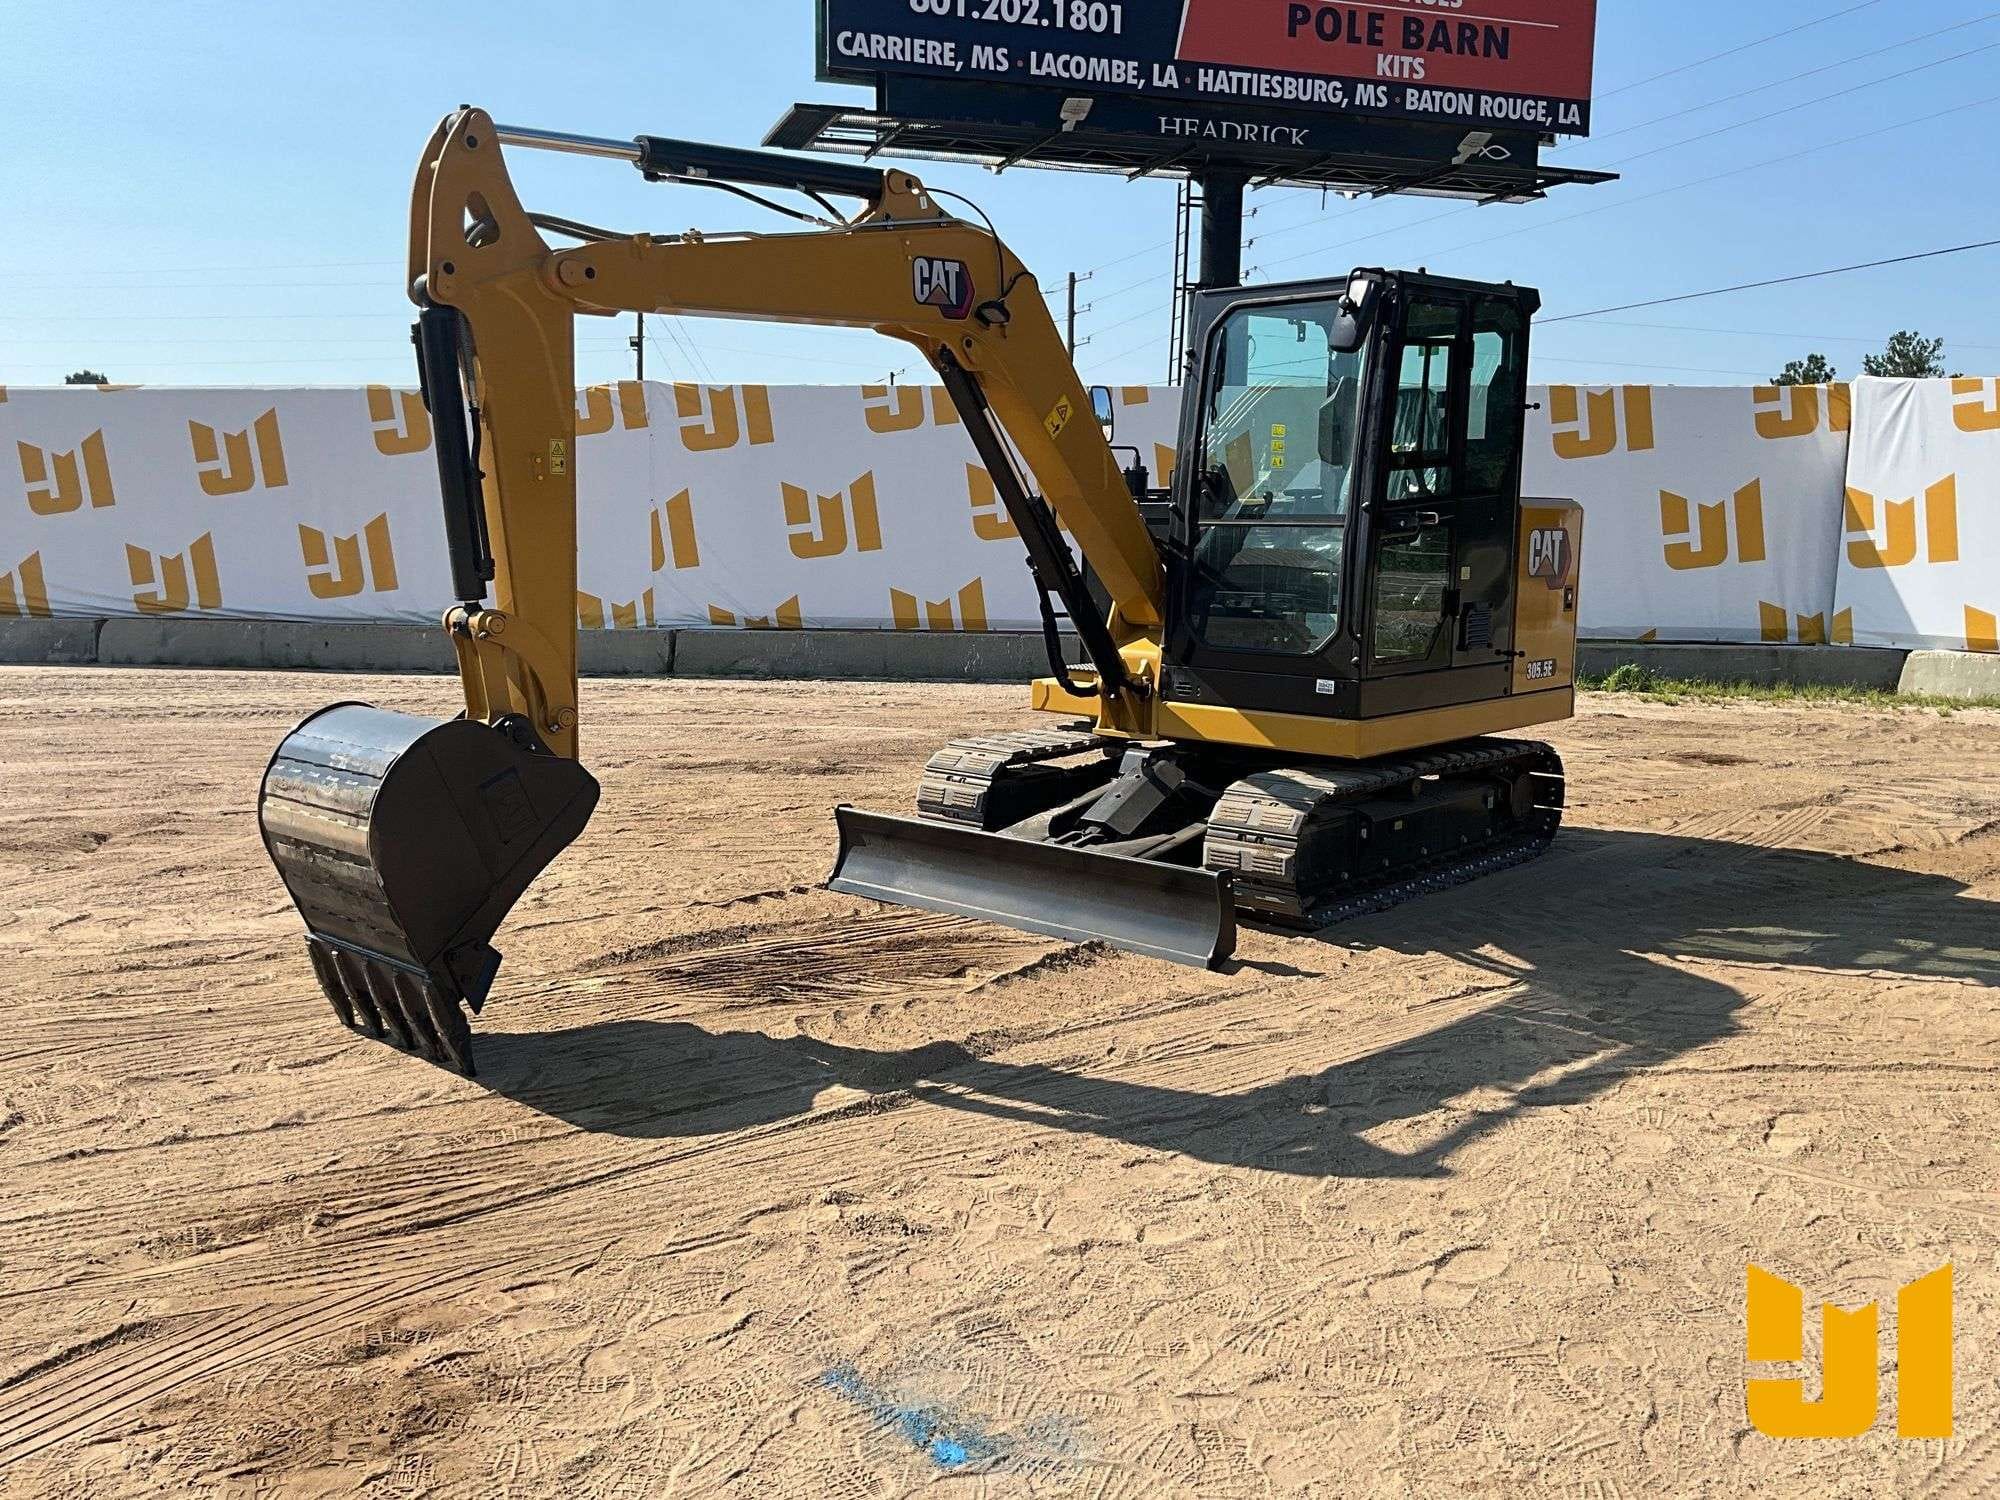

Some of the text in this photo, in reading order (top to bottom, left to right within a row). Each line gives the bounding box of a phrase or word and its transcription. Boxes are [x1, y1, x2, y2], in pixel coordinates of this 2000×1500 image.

[1287, 4, 1510, 60] POLE BARN
[836, 30, 1581, 127] CARRIERE, MS LACOMBE, LA HATTIESBURG, MS BATON ROUGE, LA
[1375, 53, 1426, 80] KITS
[1158, 116, 1310, 146] HEADRICK
[914, 257, 960, 305] CAT
[1528, 529, 1564, 576] CAT
